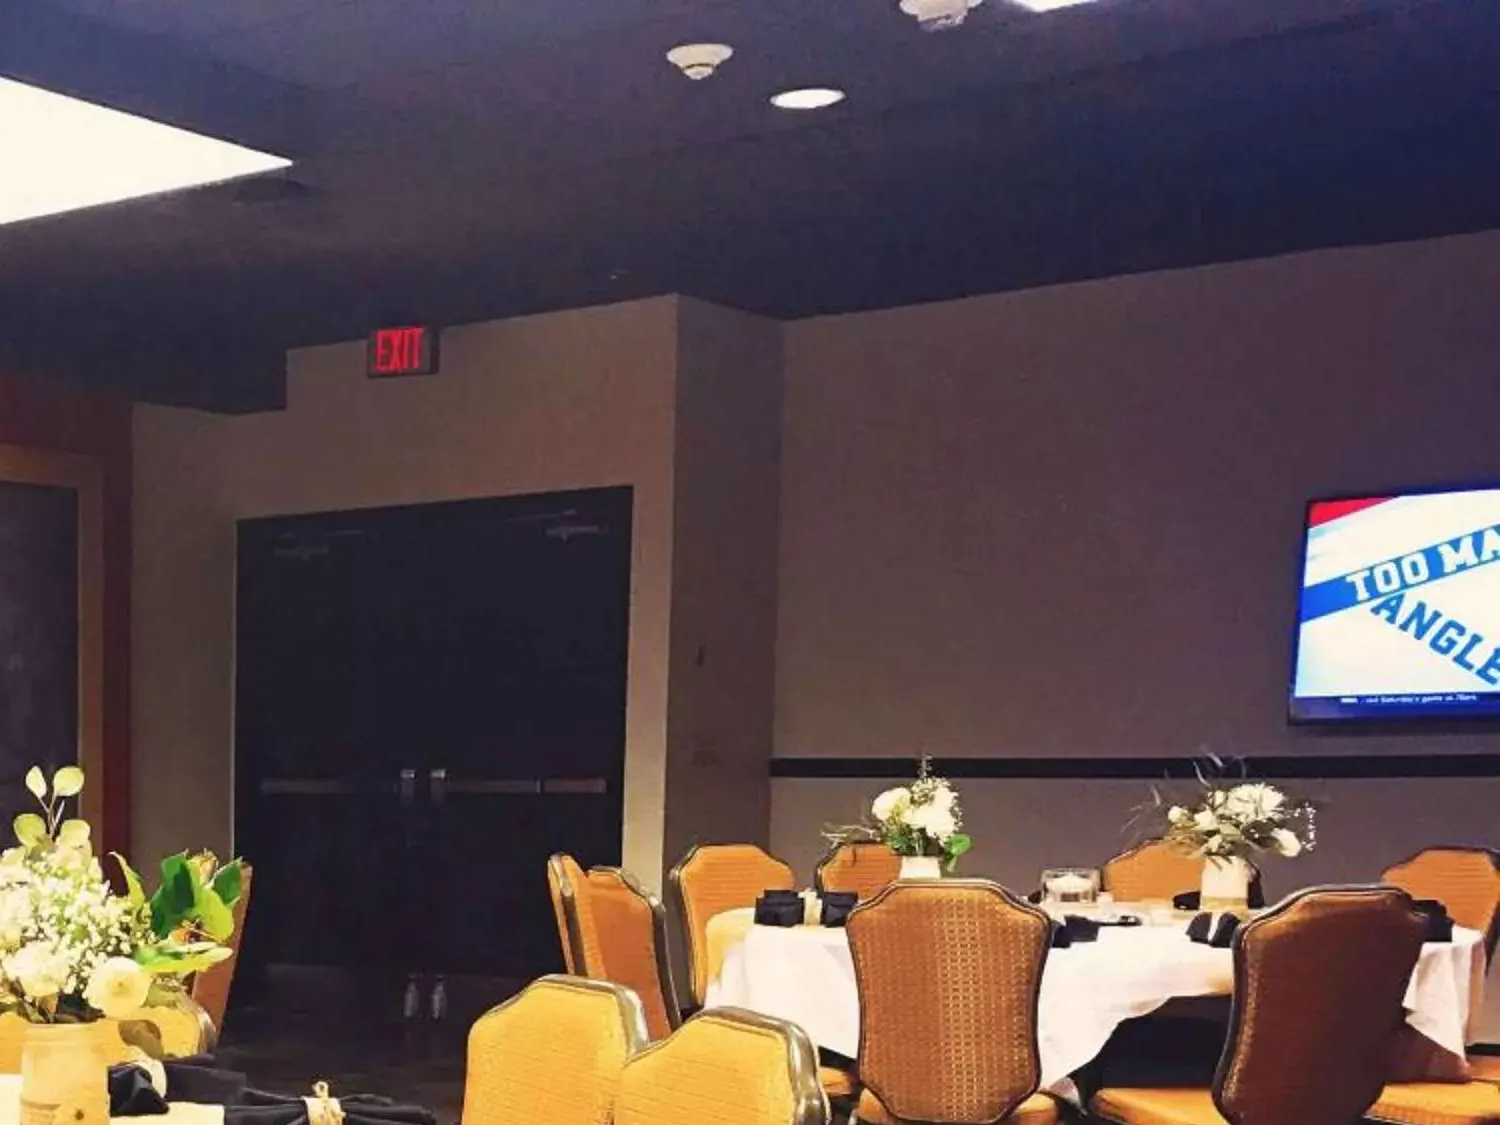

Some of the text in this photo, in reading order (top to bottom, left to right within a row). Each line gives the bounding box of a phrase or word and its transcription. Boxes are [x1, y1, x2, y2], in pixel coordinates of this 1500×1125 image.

[376, 327, 424, 370] EXIT
[1346, 551, 1430, 601] TOO
[1370, 591, 1500, 686] ANGLE
